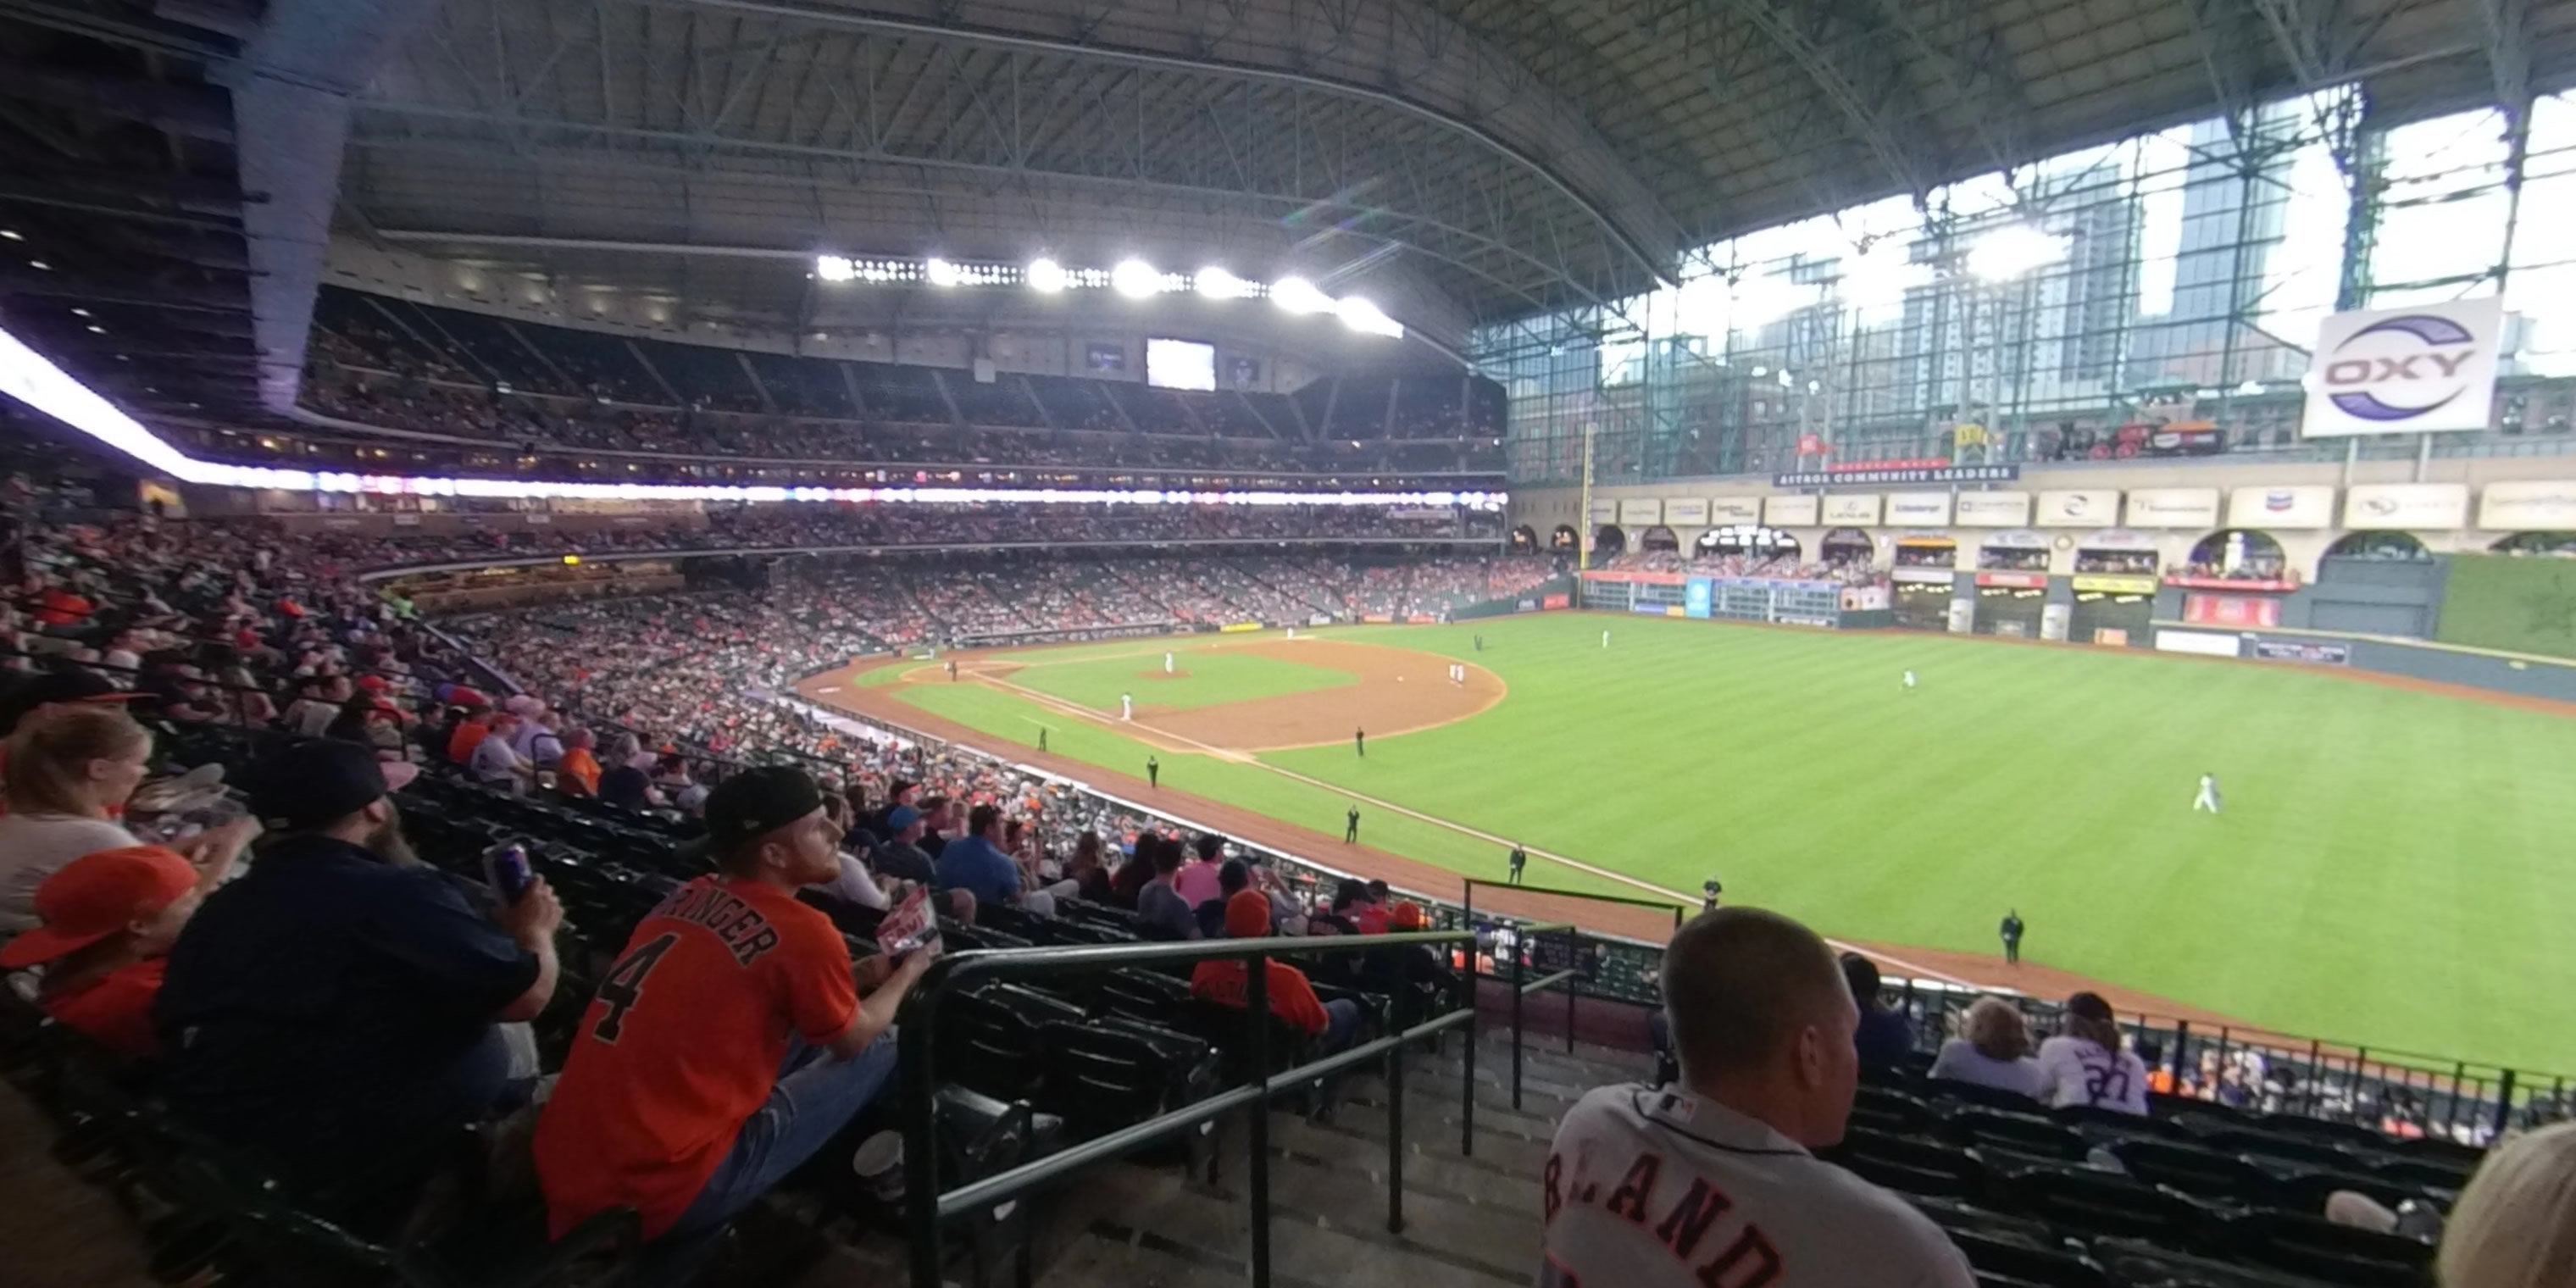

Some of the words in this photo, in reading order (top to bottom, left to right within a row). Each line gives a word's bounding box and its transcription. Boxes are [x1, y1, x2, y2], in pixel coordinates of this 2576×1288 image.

[2325, 350, 2475, 385] OXY
[1779, 474, 1829, 485] ASTROS
[1835, 470, 1928, 483] COMMUNITY
[1934, 468, 2010, 480] LEADERS
[594, 933, 680, 1045] 4
